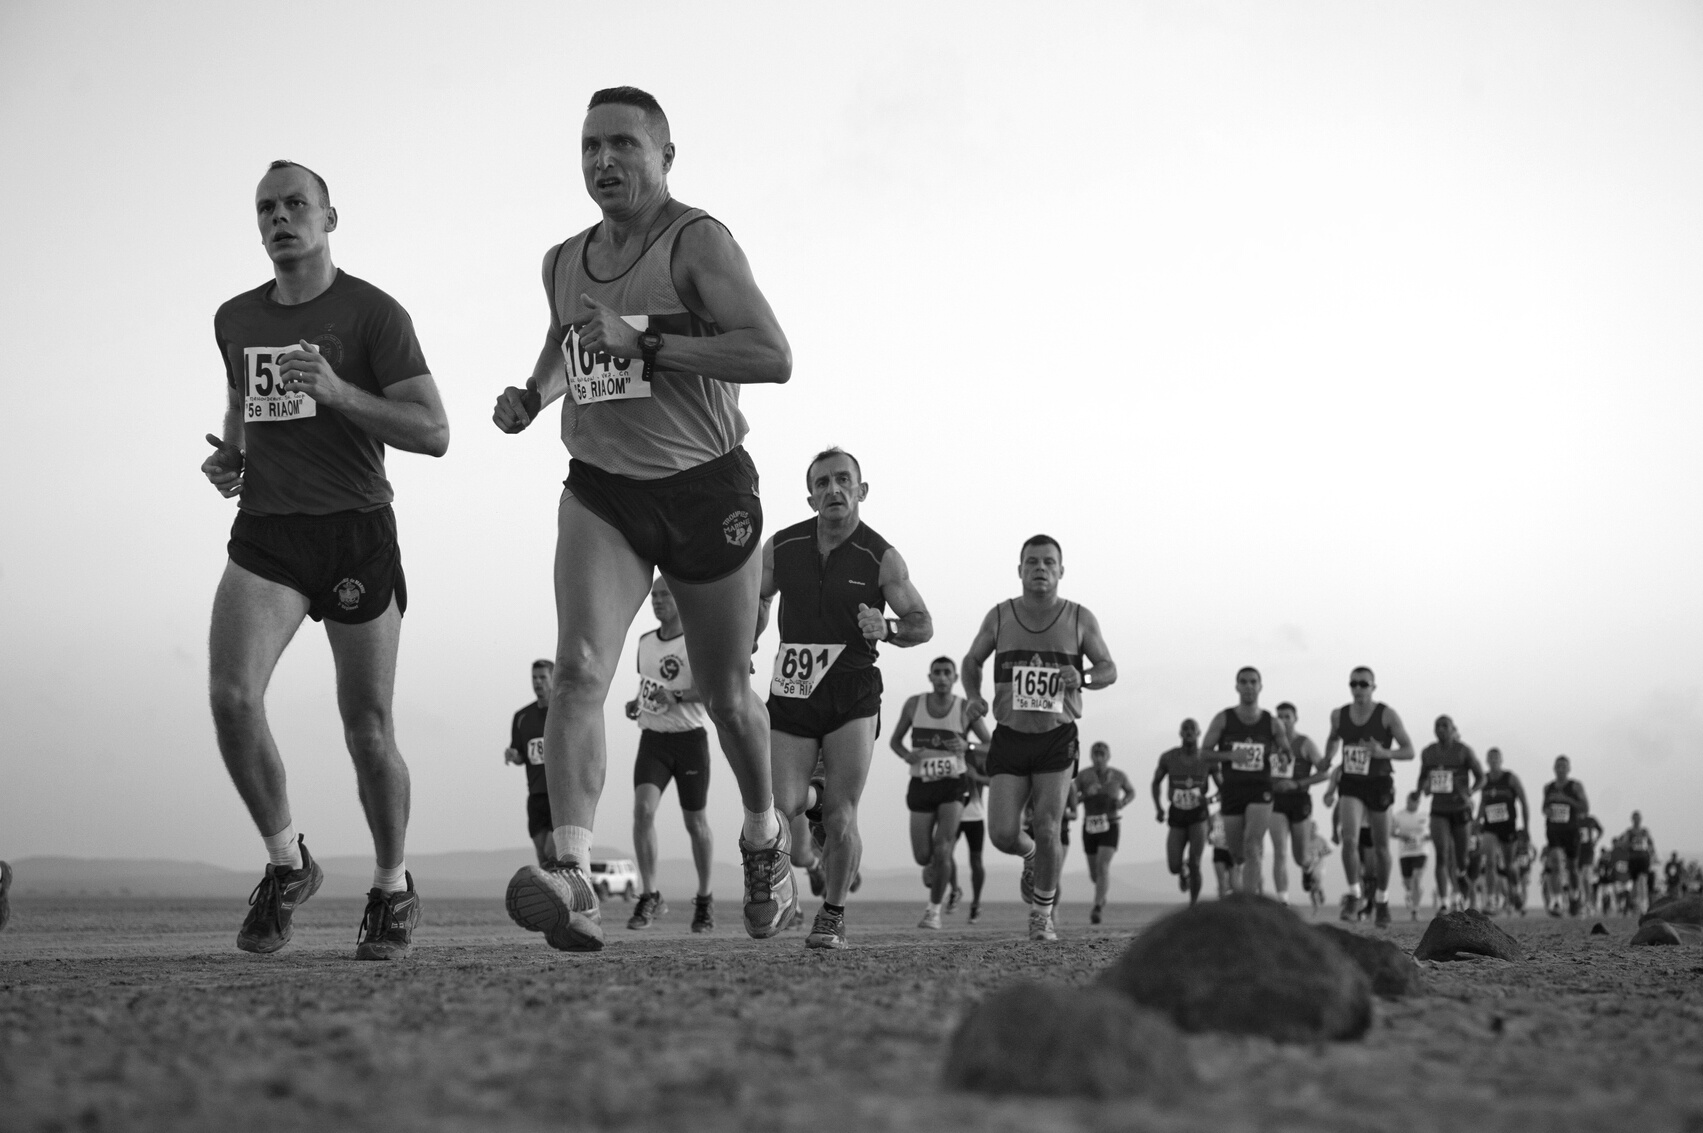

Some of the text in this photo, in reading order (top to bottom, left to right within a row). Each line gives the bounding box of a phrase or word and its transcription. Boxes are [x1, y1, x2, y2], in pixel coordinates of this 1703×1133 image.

[245, 352, 302, 397] 15
[590, 377, 632, 398] RIAOM"
[781, 648, 829, 681] 691
[1015, 670, 1061, 698] 1650
[923, 760, 952, 777] 1159
